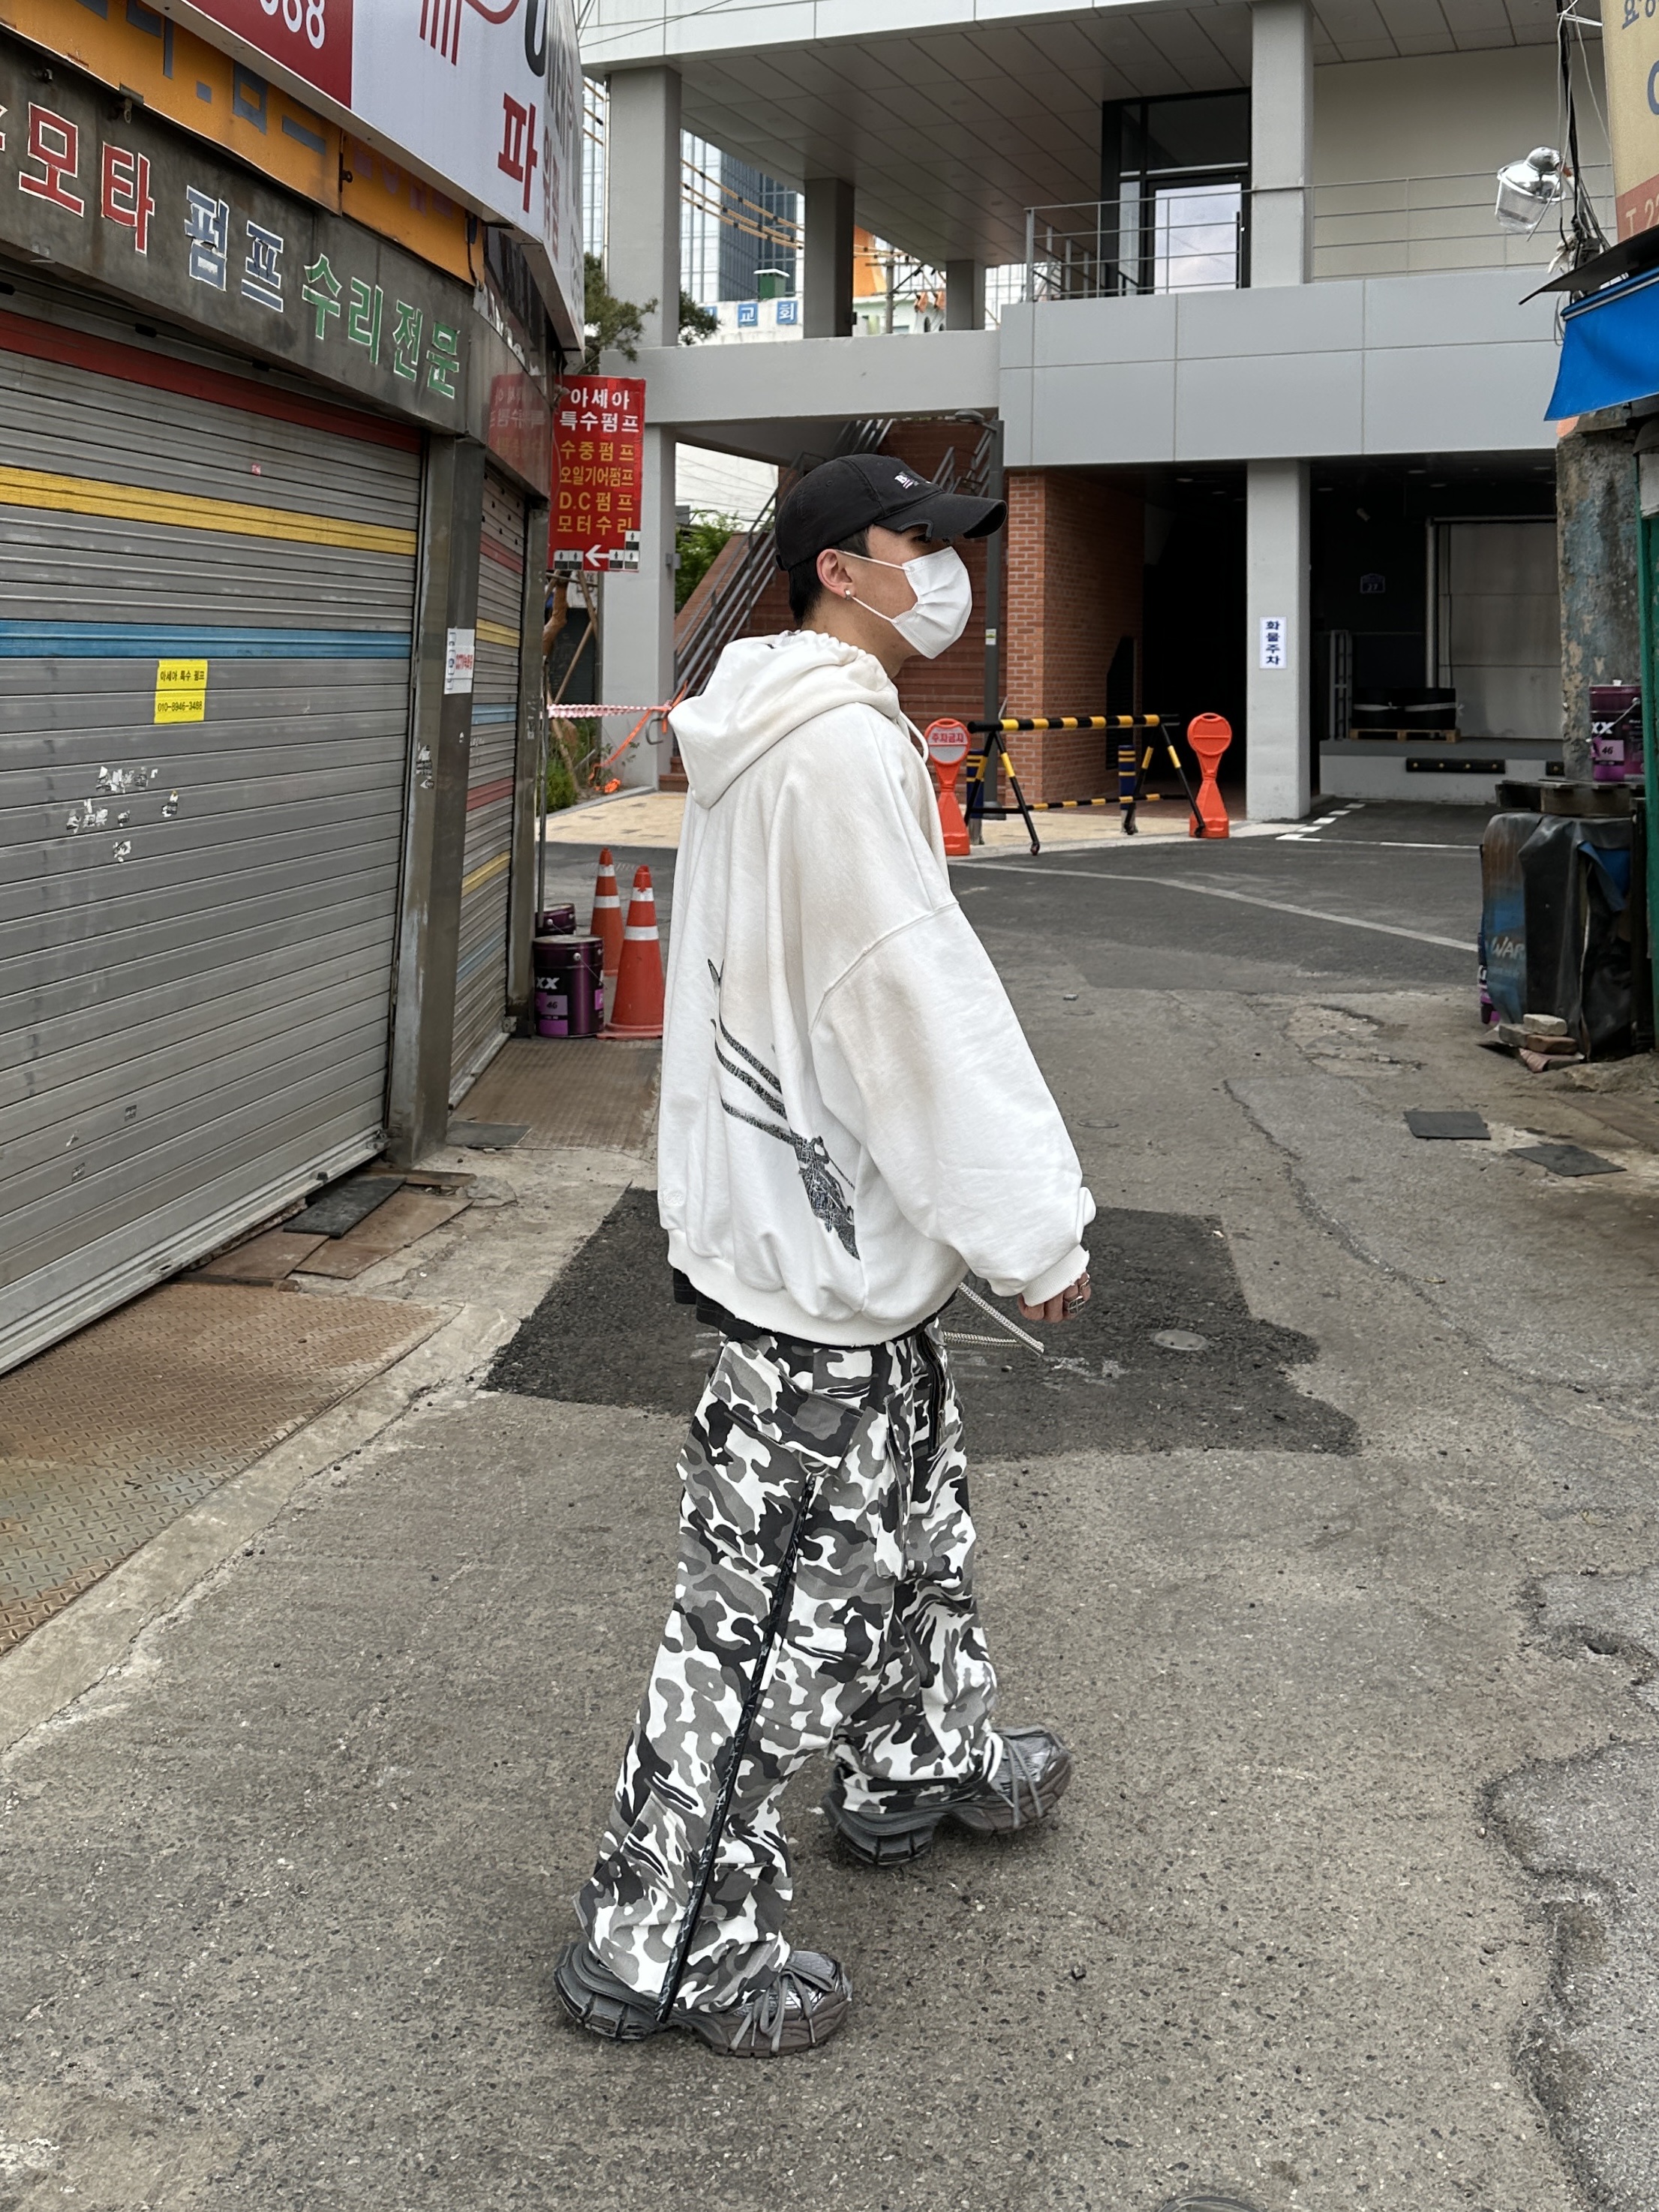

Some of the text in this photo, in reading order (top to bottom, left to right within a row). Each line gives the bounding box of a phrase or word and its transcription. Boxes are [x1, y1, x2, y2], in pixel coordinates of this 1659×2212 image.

[0, 101, 155, 257] 모타
[570, 387, 630, 410] 아세아
[560, 411, 639, 433] 특수펌프
[560, 465, 634, 487] 오일기어펌프
